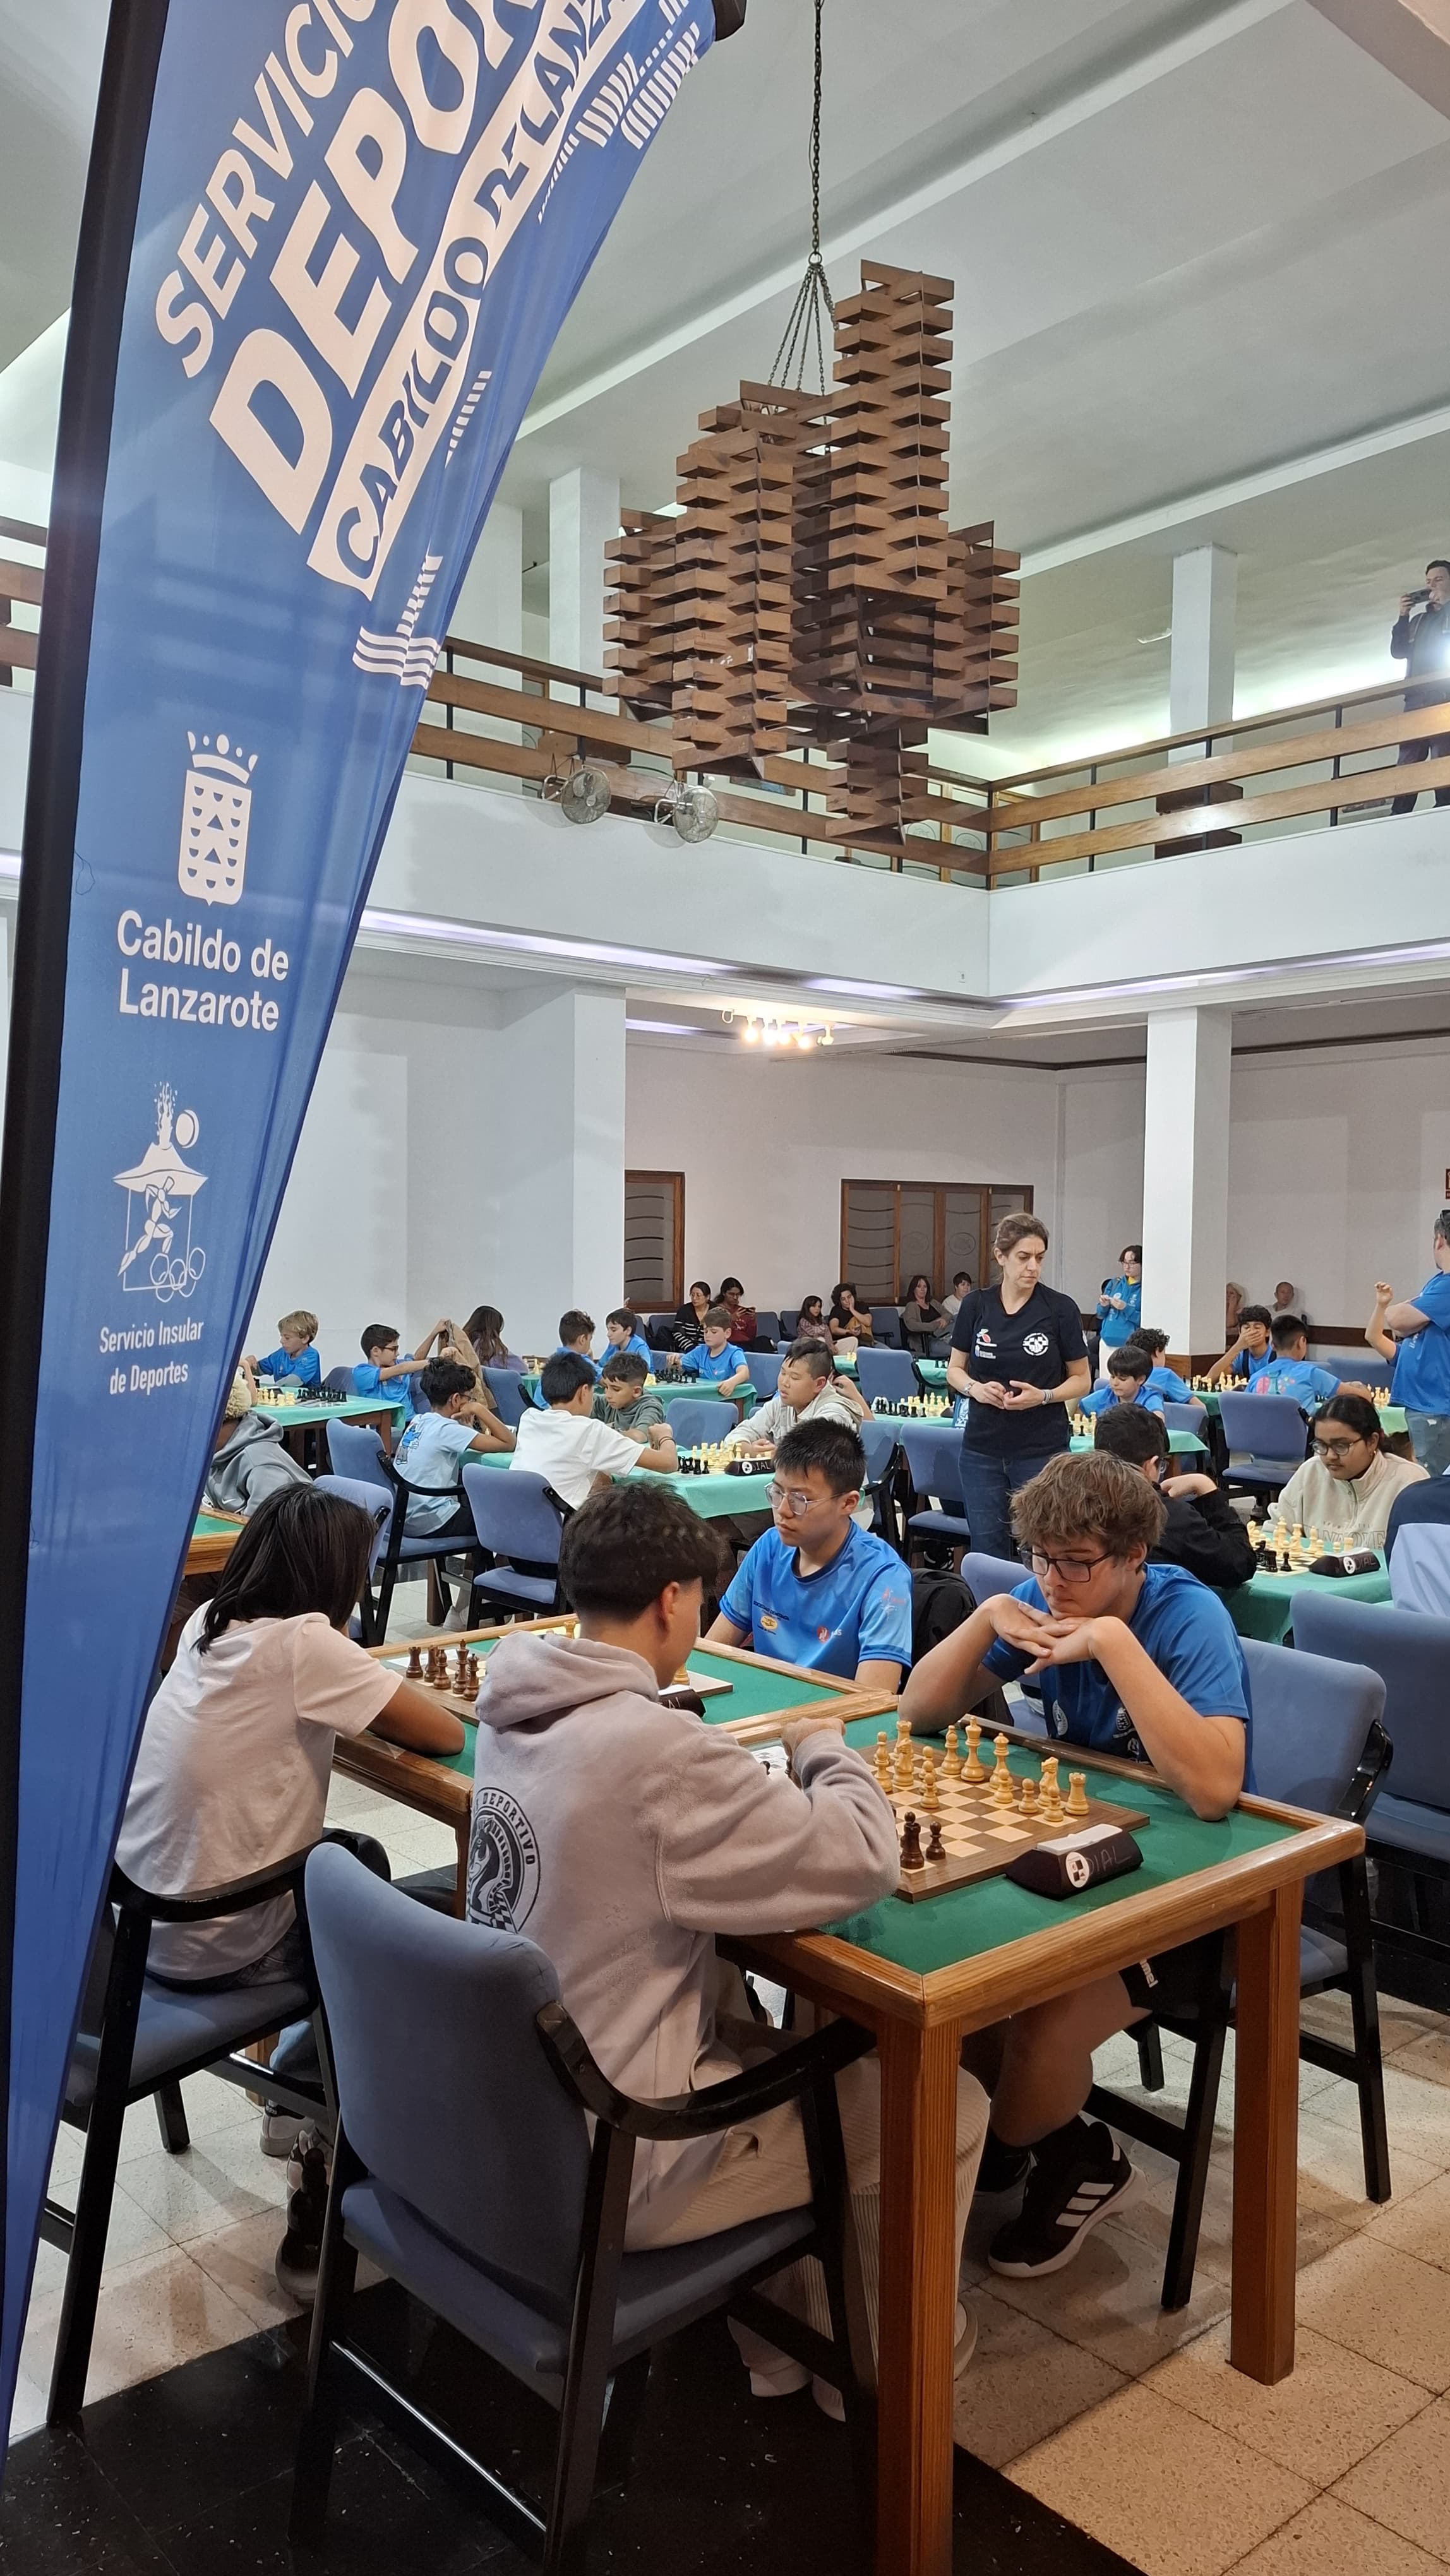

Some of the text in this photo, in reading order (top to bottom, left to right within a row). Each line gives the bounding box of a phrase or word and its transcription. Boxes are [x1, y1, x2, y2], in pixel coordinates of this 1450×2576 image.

[155, 0, 377, 378] SERVICI
[335, 236, 489, 580] CABILDO
[117, 910, 289, 981] Cabildo de
[119, 968, 279, 1031] Lanzarote
[99, 1316, 204, 1353] Servicio Insular
[110, 1361, 188, 1395] de Deportes
[482, 1792, 536, 1864] DEPORTIVO
